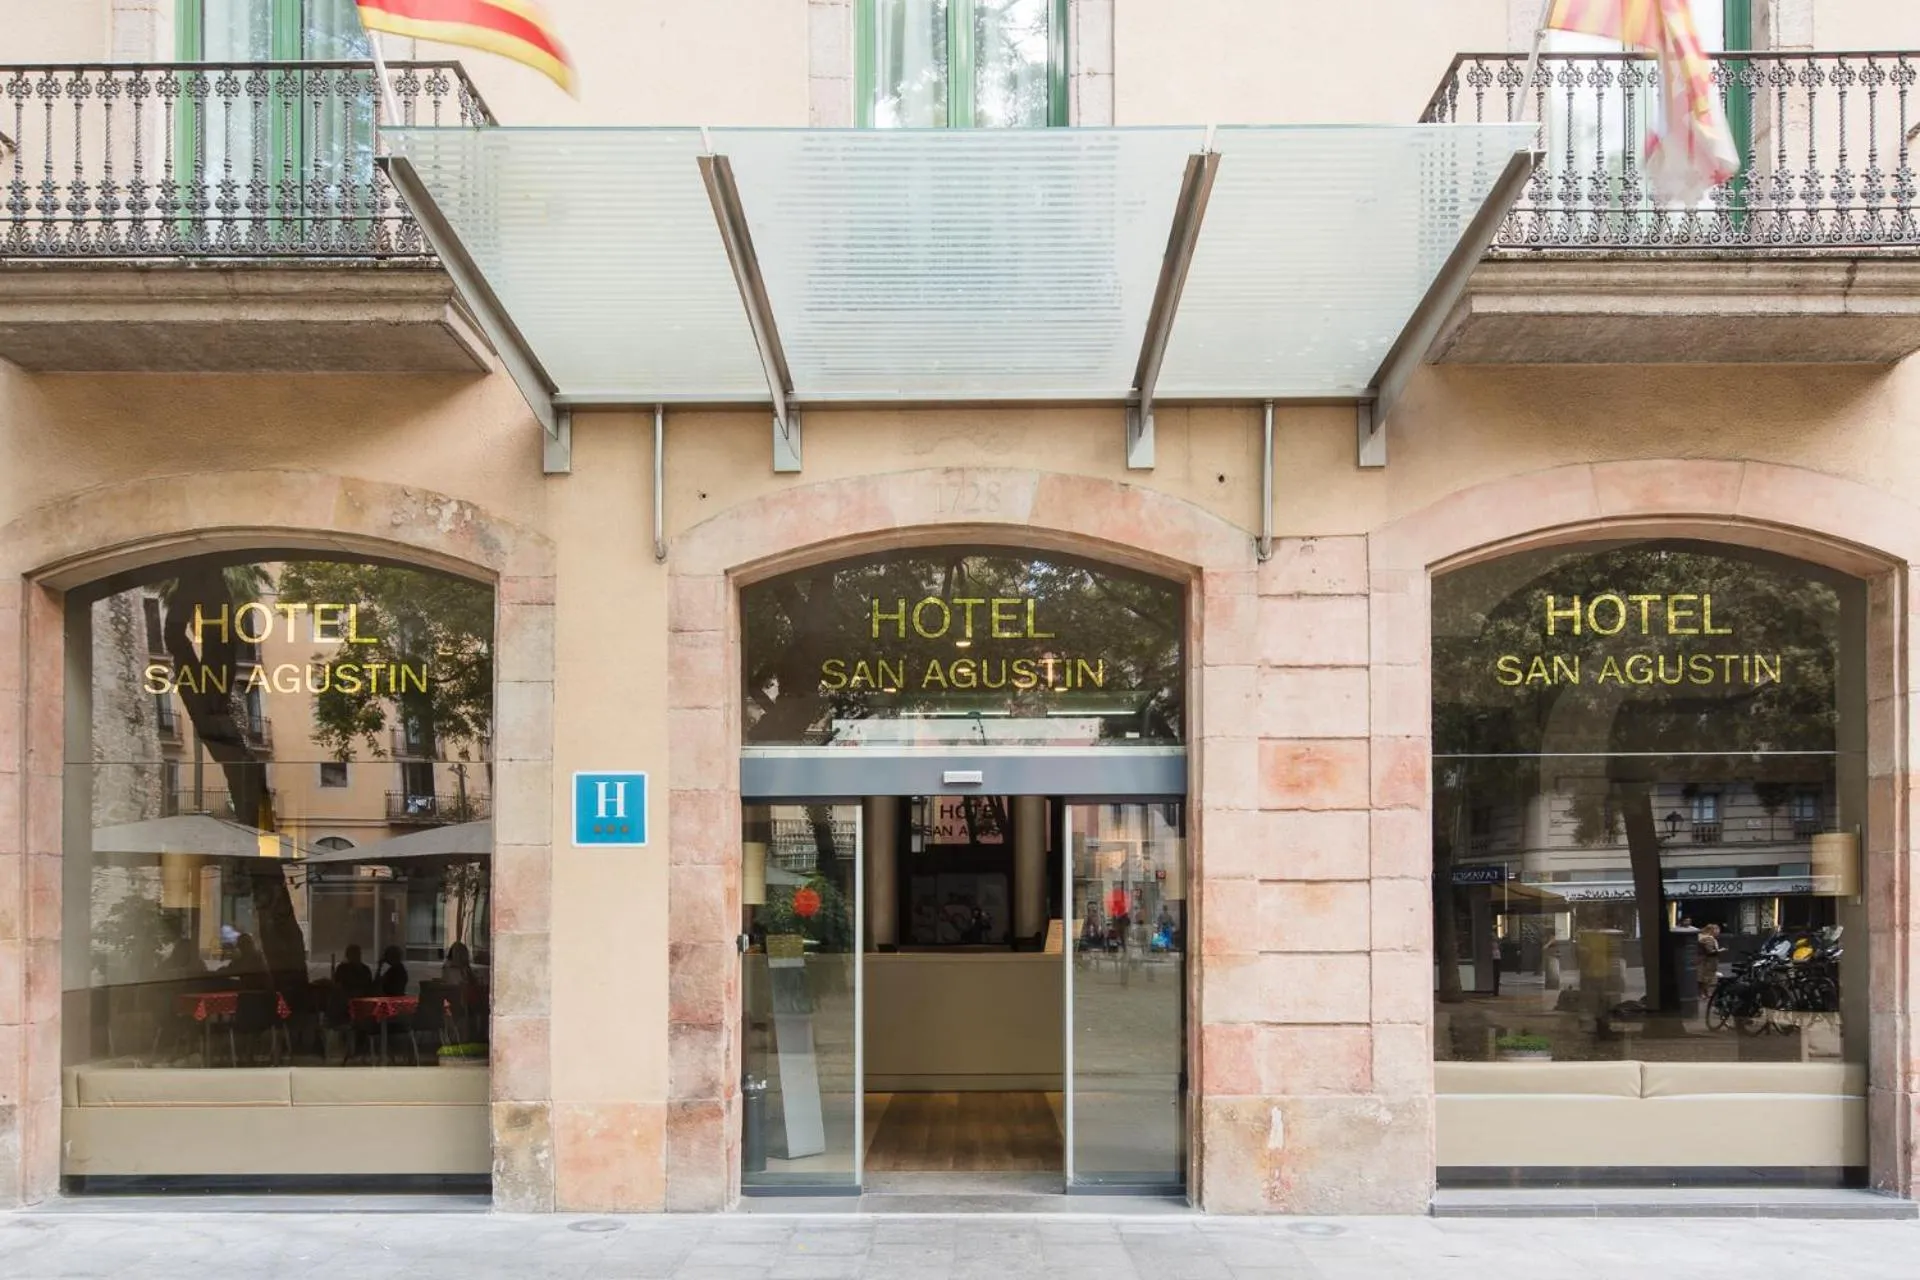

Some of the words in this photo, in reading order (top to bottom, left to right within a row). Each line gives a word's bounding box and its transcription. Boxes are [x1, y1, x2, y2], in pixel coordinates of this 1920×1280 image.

[193, 602, 379, 645] HOTEL
[871, 596, 1056, 639] HOTEL
[1545, 593, 1733, 636] HOTEL
[143, 663, 228, 695] SAN
[244, 663, 429, 695] AGUSTIN
[821, 658, 905, 690] SAN
[920, 658, 1105, 690] AGUSTIN
[1495, 653, 1581, 686] SAN
[1597, 653, 1783, 686] AGUSTIN
[593, 781, 631, 818] H
